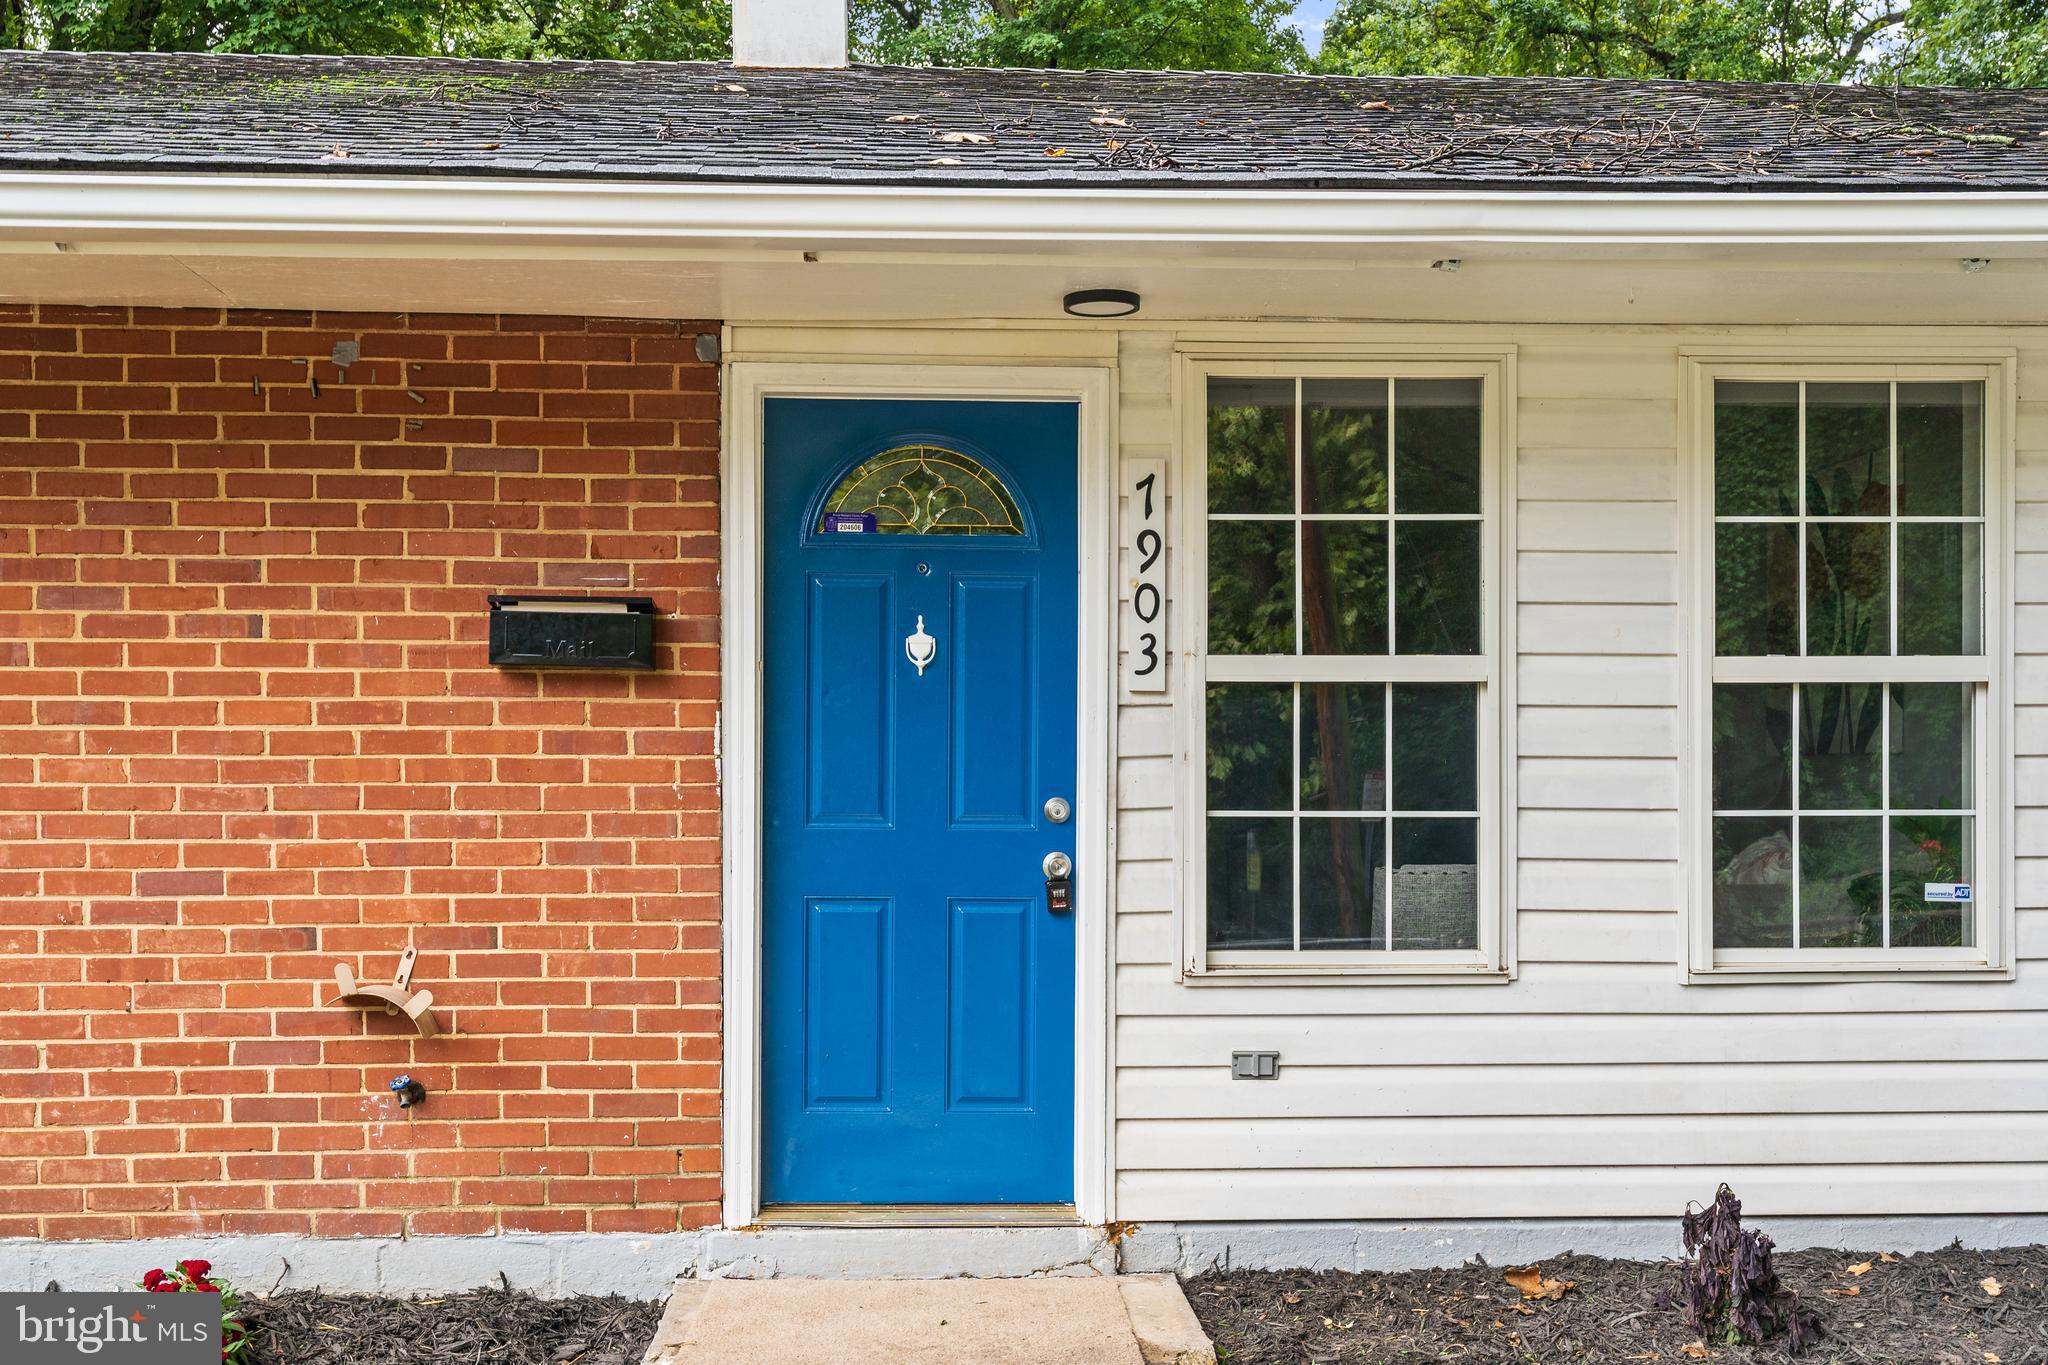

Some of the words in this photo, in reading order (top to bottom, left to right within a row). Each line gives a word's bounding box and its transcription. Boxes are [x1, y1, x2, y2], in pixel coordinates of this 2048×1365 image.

[1134, 473, 1162, 676] 1903
[545, 639, 596, 658] Mail
[1955, 888, 1970, 898] ADT
